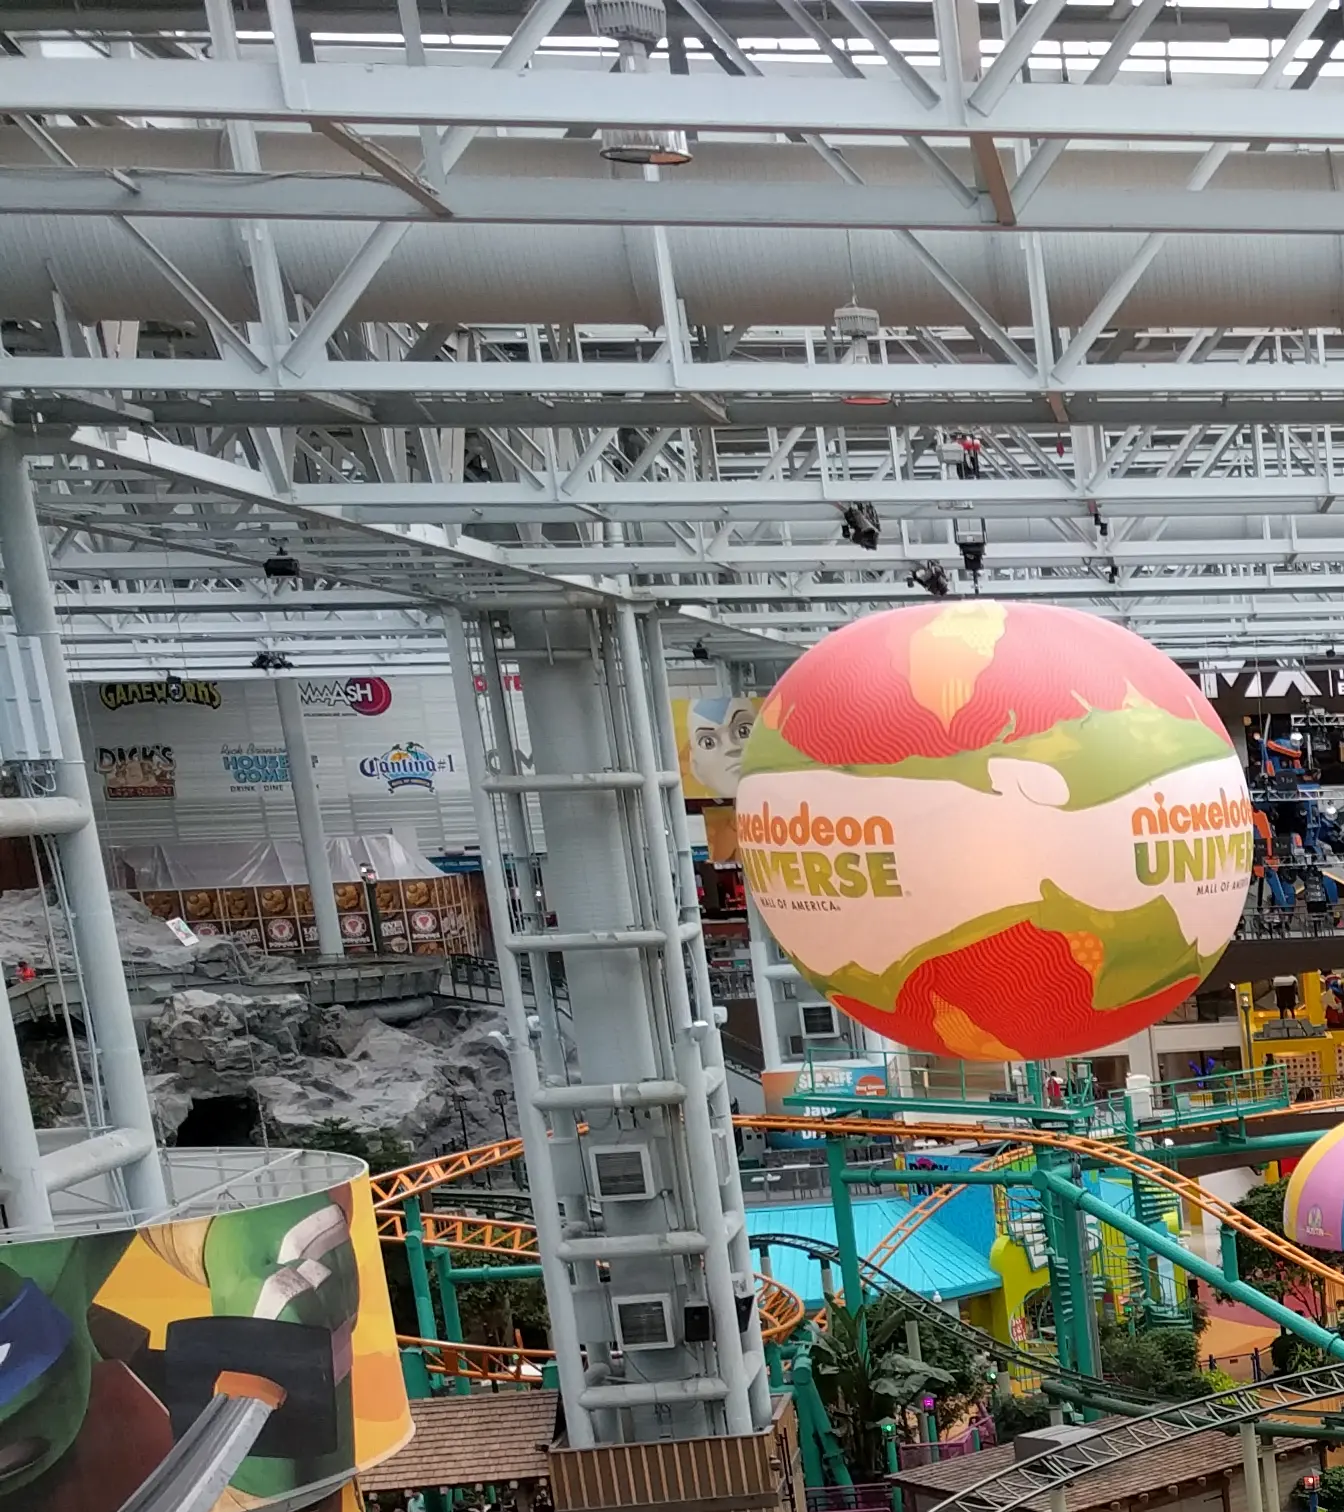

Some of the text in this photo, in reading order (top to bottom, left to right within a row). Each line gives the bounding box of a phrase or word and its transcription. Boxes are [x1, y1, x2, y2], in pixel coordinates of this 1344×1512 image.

[100, 681, 221, 710] GAMEWORKS
[96, 745, 175, 773] DICK'S
[223, 755, 290, 770] HOUSE
[233, 769, 290, 784] COME
[738, 801, 895, 846] kelodeon
[1131, 785, 1253, 836] nickelod
[742, 848, 903, 898] NIVERSE
[1196, 882, 1217, 896] MALL
[1220, 882, 1230, 892] OF
[777, 900, 788, 910] OF
